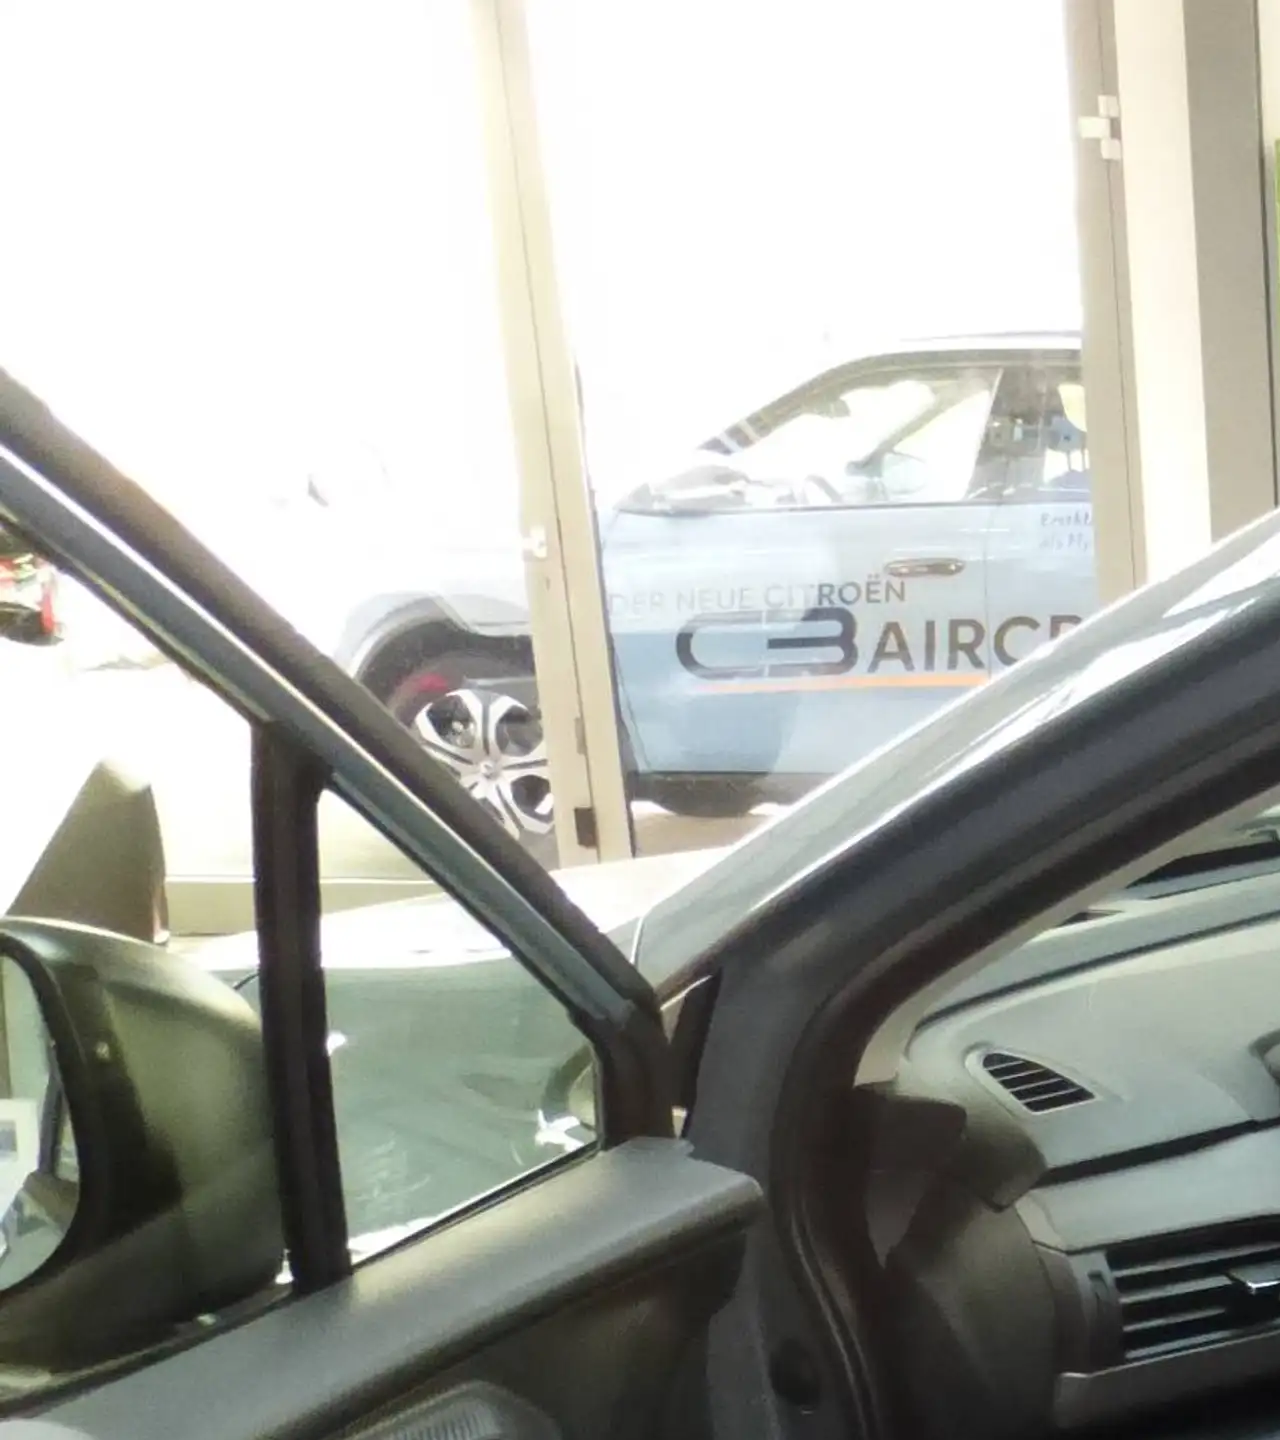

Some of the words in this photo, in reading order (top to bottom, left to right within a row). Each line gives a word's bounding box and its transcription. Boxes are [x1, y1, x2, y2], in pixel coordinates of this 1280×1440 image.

[609, 593, 665, 616] DER
[676, 586, 754, 611] NEUE
[763, 573, 906, 609] CITROËN
